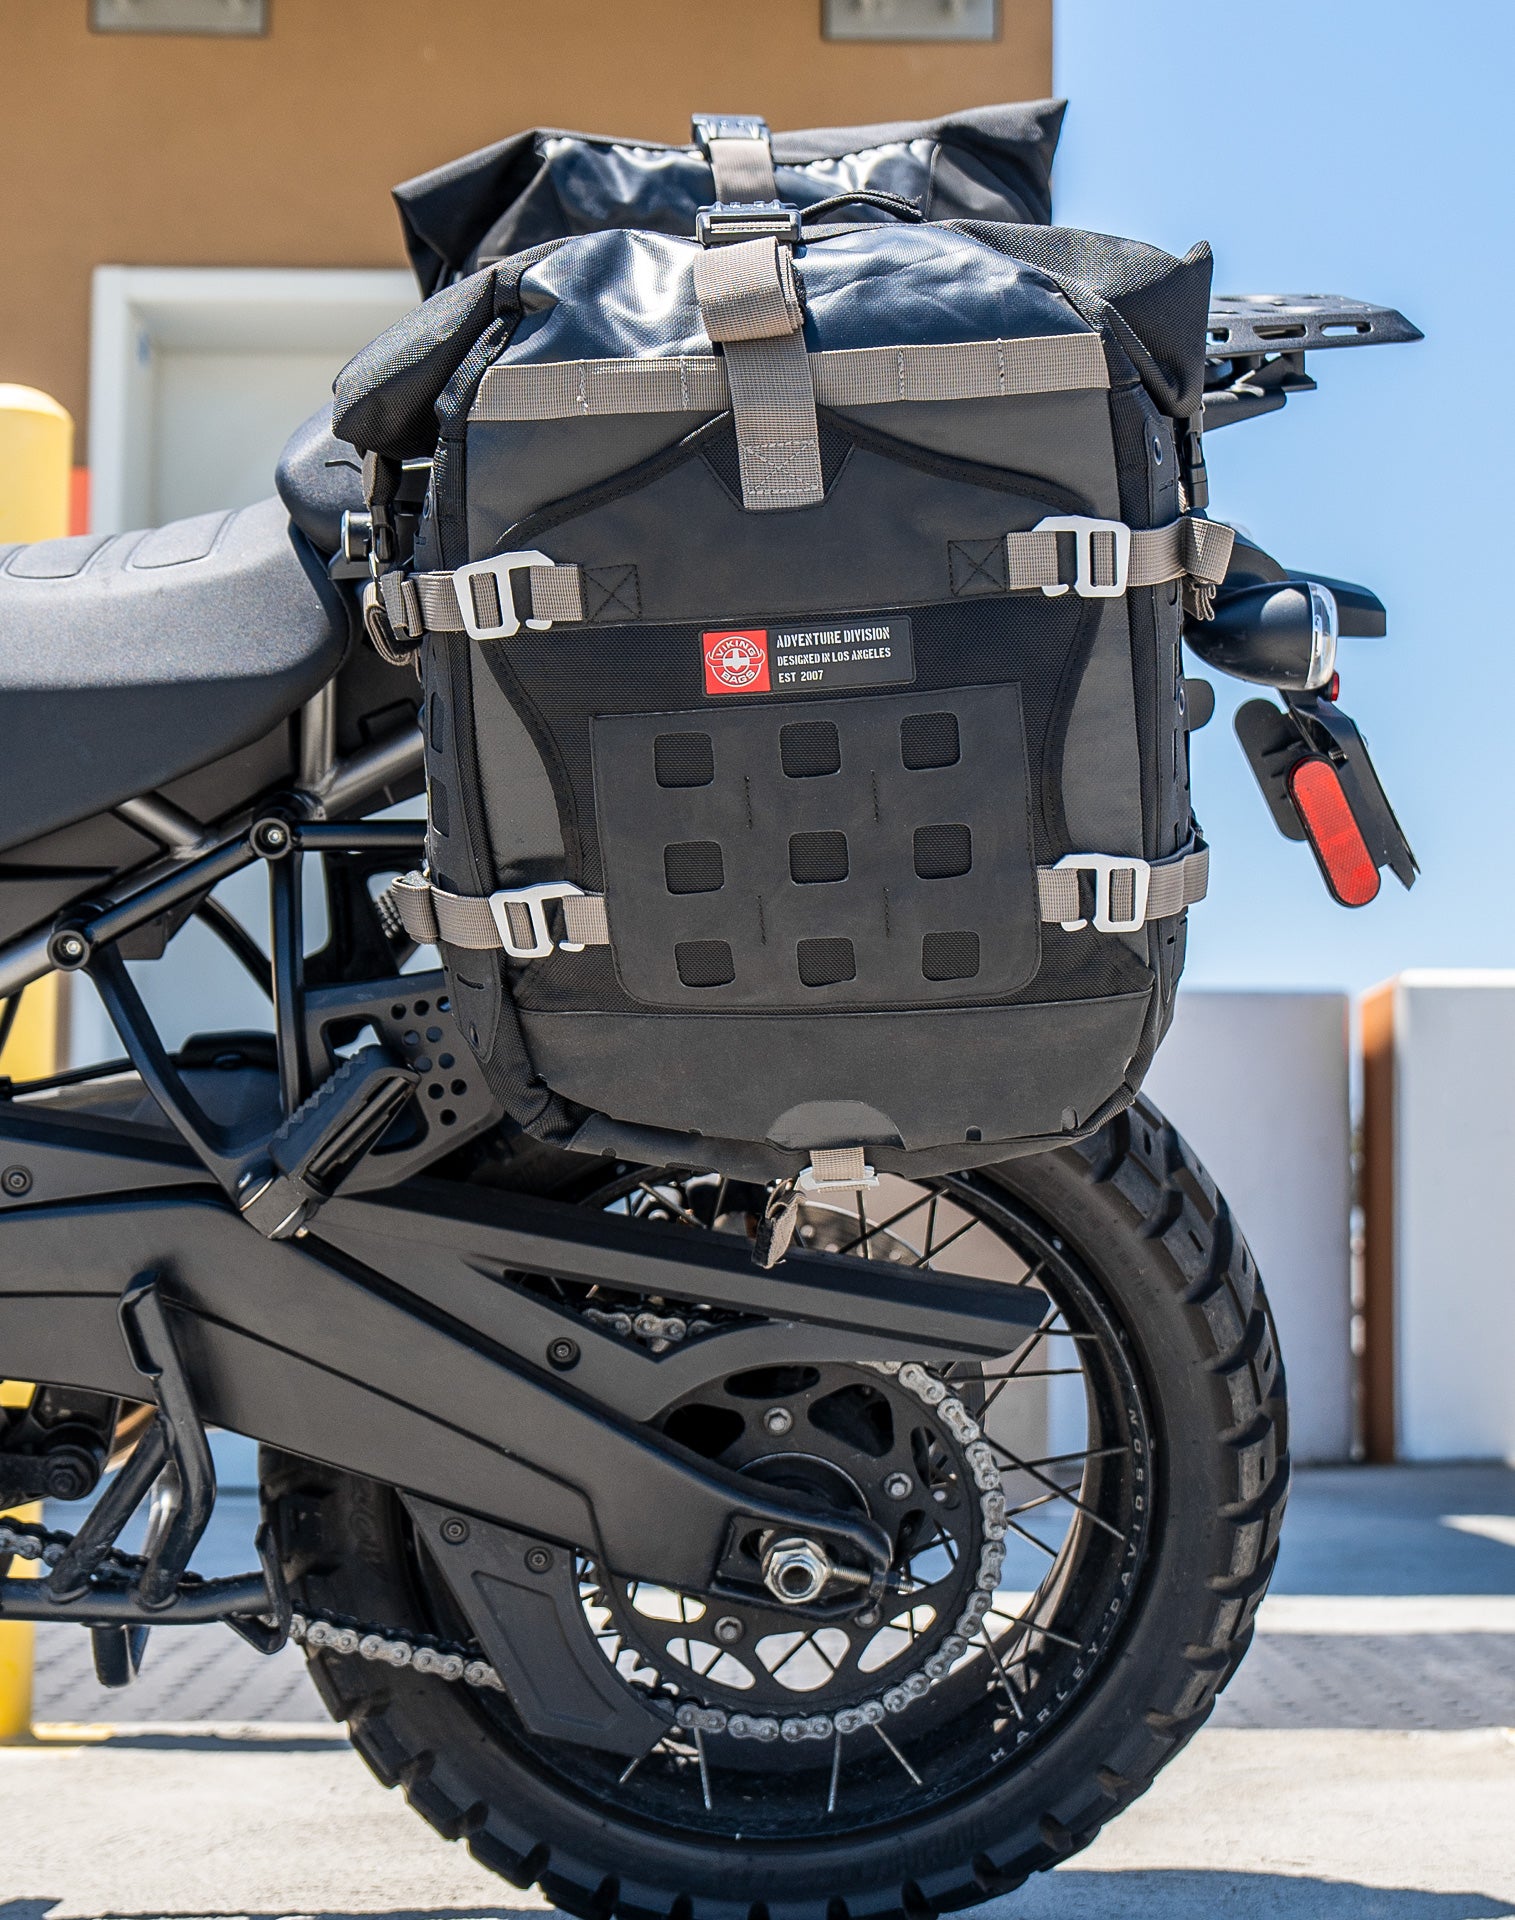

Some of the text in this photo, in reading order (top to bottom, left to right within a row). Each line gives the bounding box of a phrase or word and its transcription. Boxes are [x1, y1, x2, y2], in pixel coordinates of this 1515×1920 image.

[776, 627, 891, 648] ADVENTURE DIVISION
[716, 640, 756, 657] VIKING
[777, 647, 892, 667] DESIGNED IN LOS ANGELES
[721, 670, 756, 684] BAGS
[778, 670, 824, 683] EST 2007
